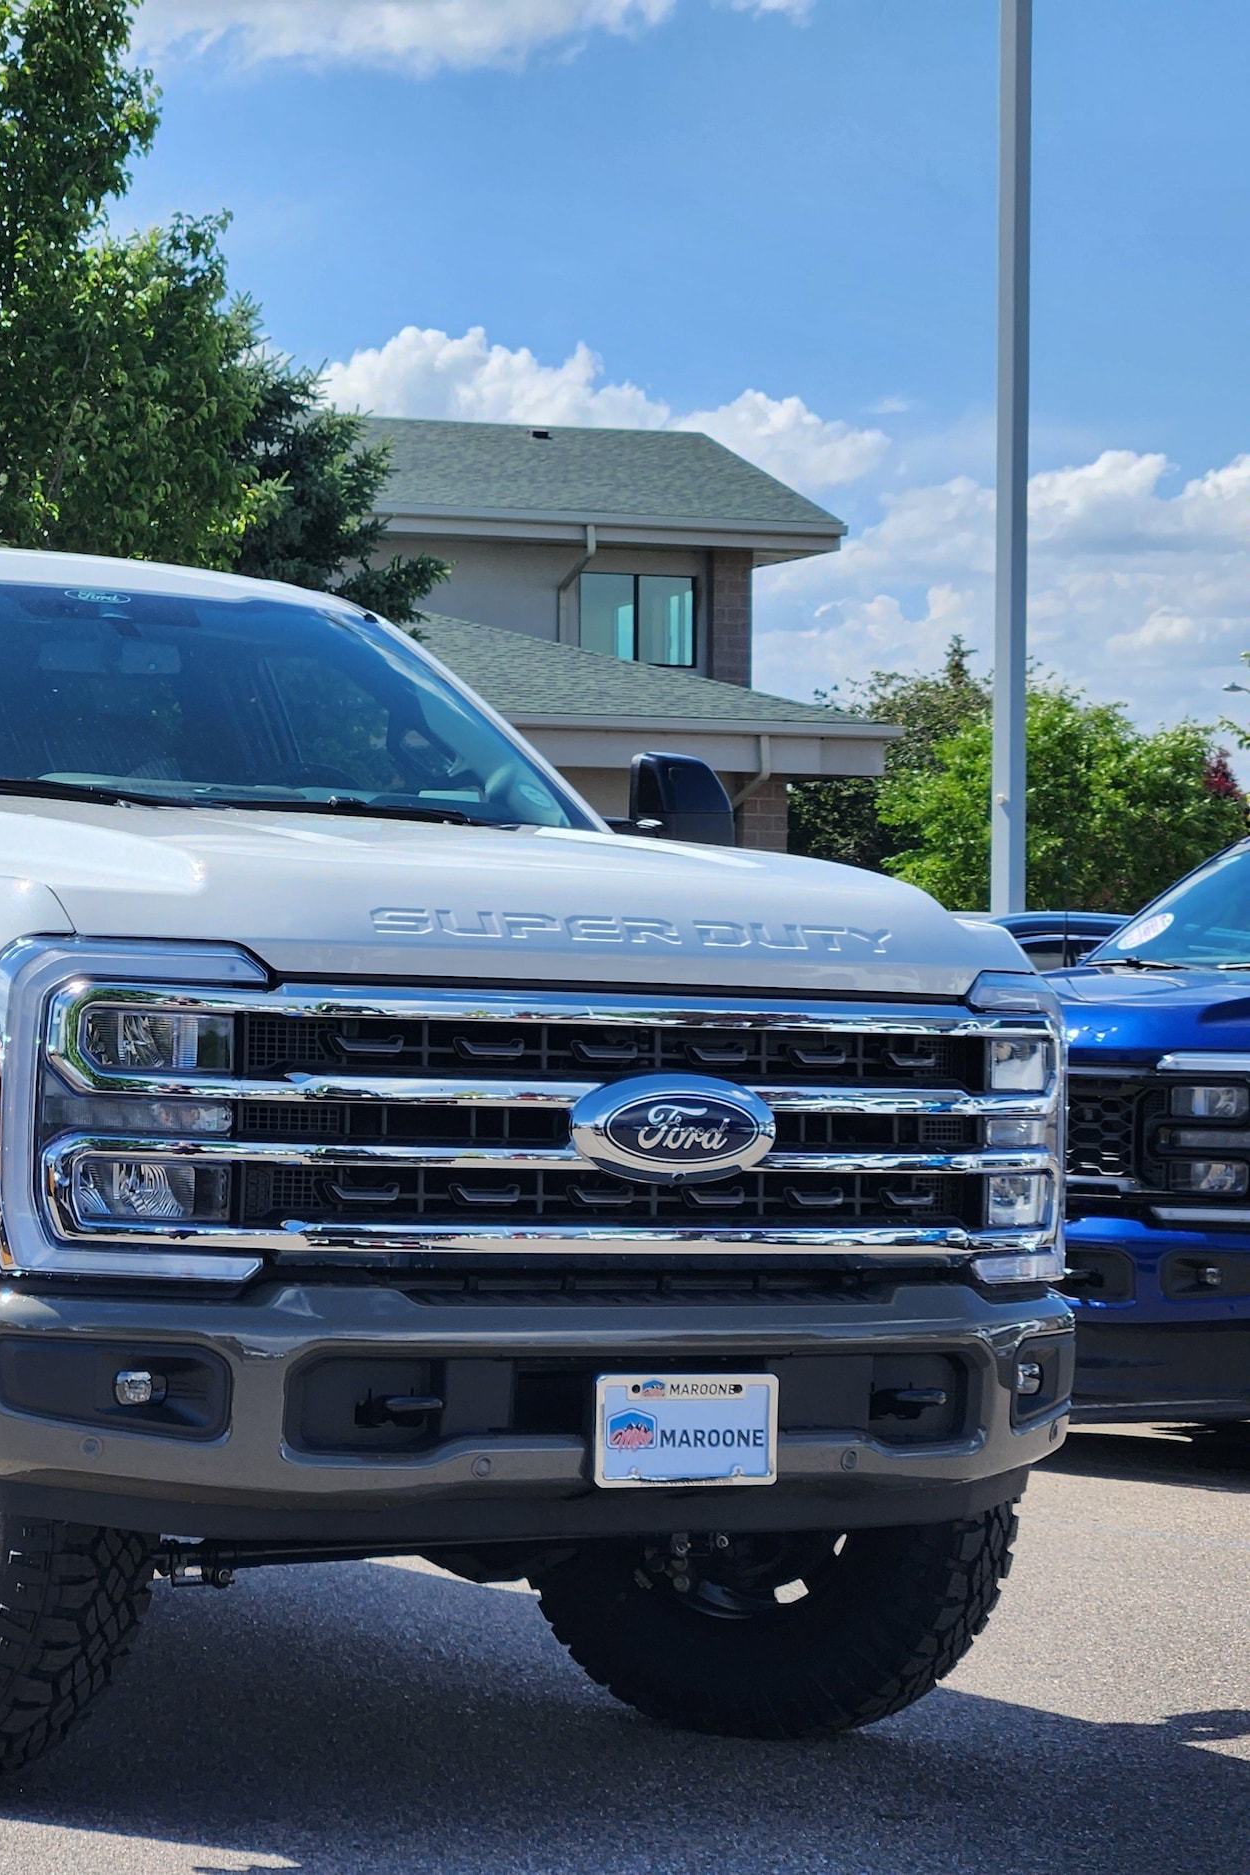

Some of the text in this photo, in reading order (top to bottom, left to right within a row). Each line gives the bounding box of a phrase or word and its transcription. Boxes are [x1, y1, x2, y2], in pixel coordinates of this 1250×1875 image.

[77, 590, 120, 602] Ford
[369, 906, 893, 953] SUPER DUTY
[637, 1104, 730, 1150] Ford
[669, 1383, 736, 1395] MAROONE
[659, 1429, 764, 1448] MAROONE
